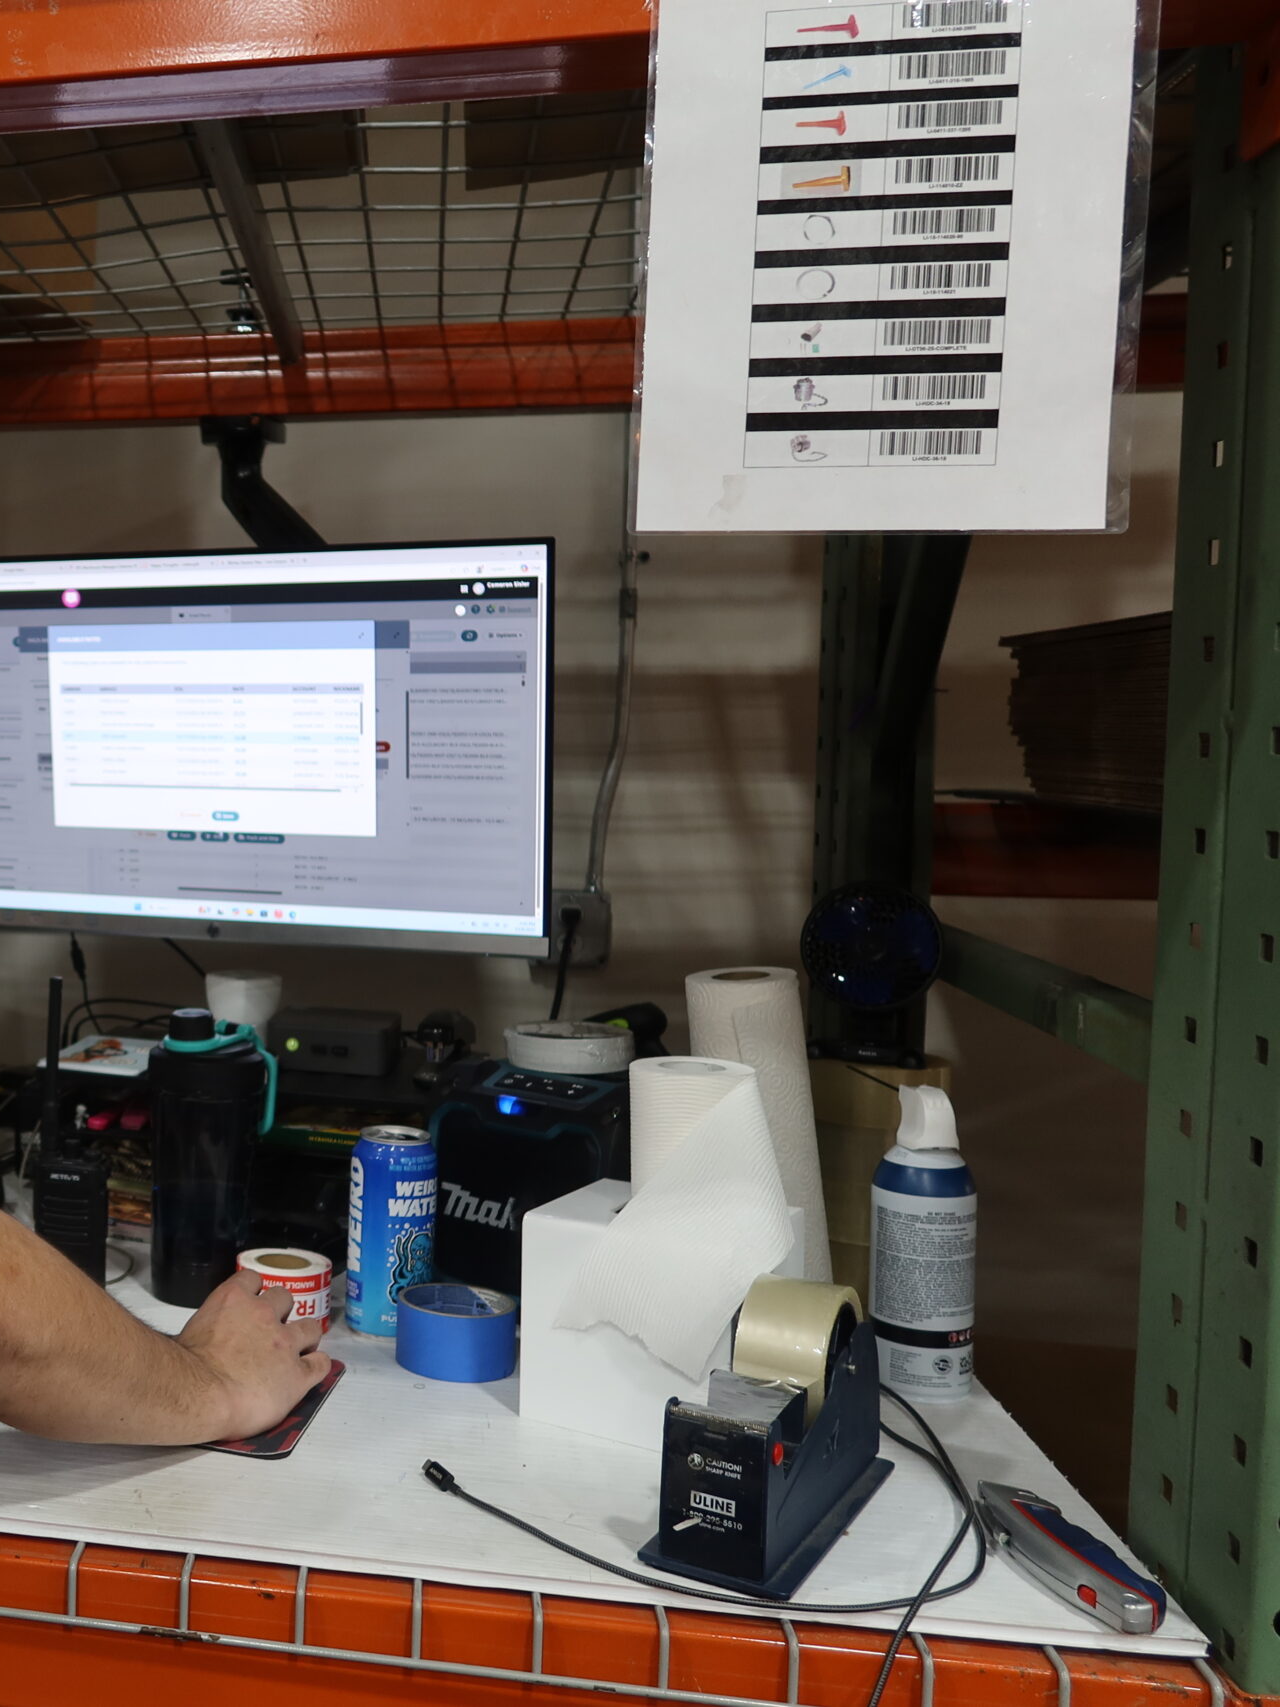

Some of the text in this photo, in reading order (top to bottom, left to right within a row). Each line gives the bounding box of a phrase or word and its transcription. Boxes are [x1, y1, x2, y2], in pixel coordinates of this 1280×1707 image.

[395, 1180, 438, 1199] WEIR
[347, 1155, 366, 1274] WEIRD
[387, 1197, 437, 1218] WATE
[440, 1181, 517, 1231] Mak
[285, 1279, 315, 1289] HANDLE
[293, 1298, 316, 1317] FR
[705, 1466, 741, 1480] SHARP KNIFE
[706, 1458, 742, 1473] CAUTION!
[693, 1493, 733, 1514] ULINE
